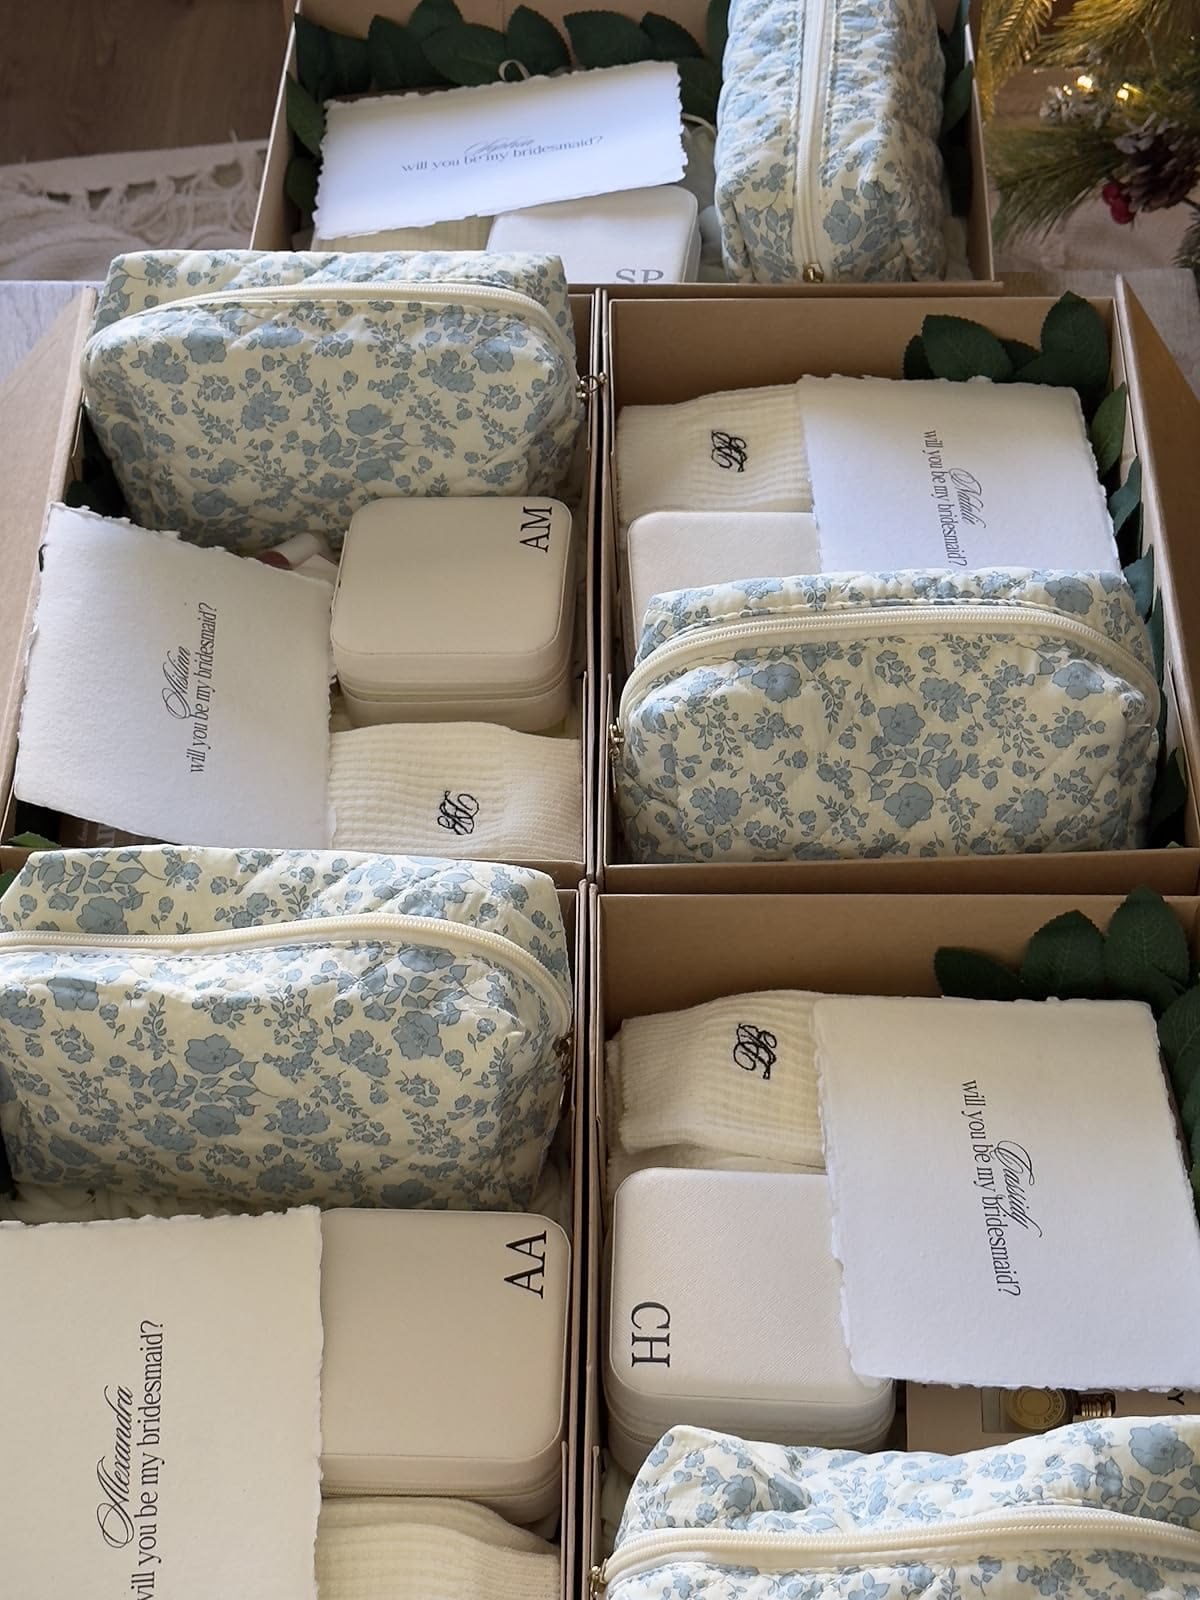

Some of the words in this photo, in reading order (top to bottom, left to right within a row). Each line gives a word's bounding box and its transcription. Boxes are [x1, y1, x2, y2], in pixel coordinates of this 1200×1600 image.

[402, 160, 428, 172] will
[433, 158, 460, 171] you
[464, 155, 482, 166] be
[486, 152, 510, 164] my
[513, 136, 604, 158] bridesmaid?
[924, 430, 944, 448] will
[922, 450, 943, 469] you
[930, 470, 950, 485] be
[931, 485, 950, 502] my
[949, 467, 987, 529] Natalie
[519, 506, 553, 553] AM
[937, 503, 968, 567] bridesmaid?
[193, 602, 218, 680] bridesmaid?
[196, 680, 216, 703] my
[190, 703, 210, 721] be
[192, 721, 212, 750] you
[186, 748, 206, 773] will
[962, 1080, 987, 1106] will
[961, 1110, 987, 1140] you
[972, 1144, 994, 1163] be
[973, 1167, 996, 1193] my
[989, 1140, 1043, 1238] Cassidy
[981, 1196, 1021, 1297] bridesmaid?
[503, 1230, 547, 1300] AA
[631, 1301, 671, 1368] CH
[136, 1319, 164, 1447] bridesmaid?
[96, 1384, 135, 1549] Alexandra
[140, 1452, 166, 1486] my
[133, 1491, 159, 1519] be
[138, 1523, 162, 1567] you
